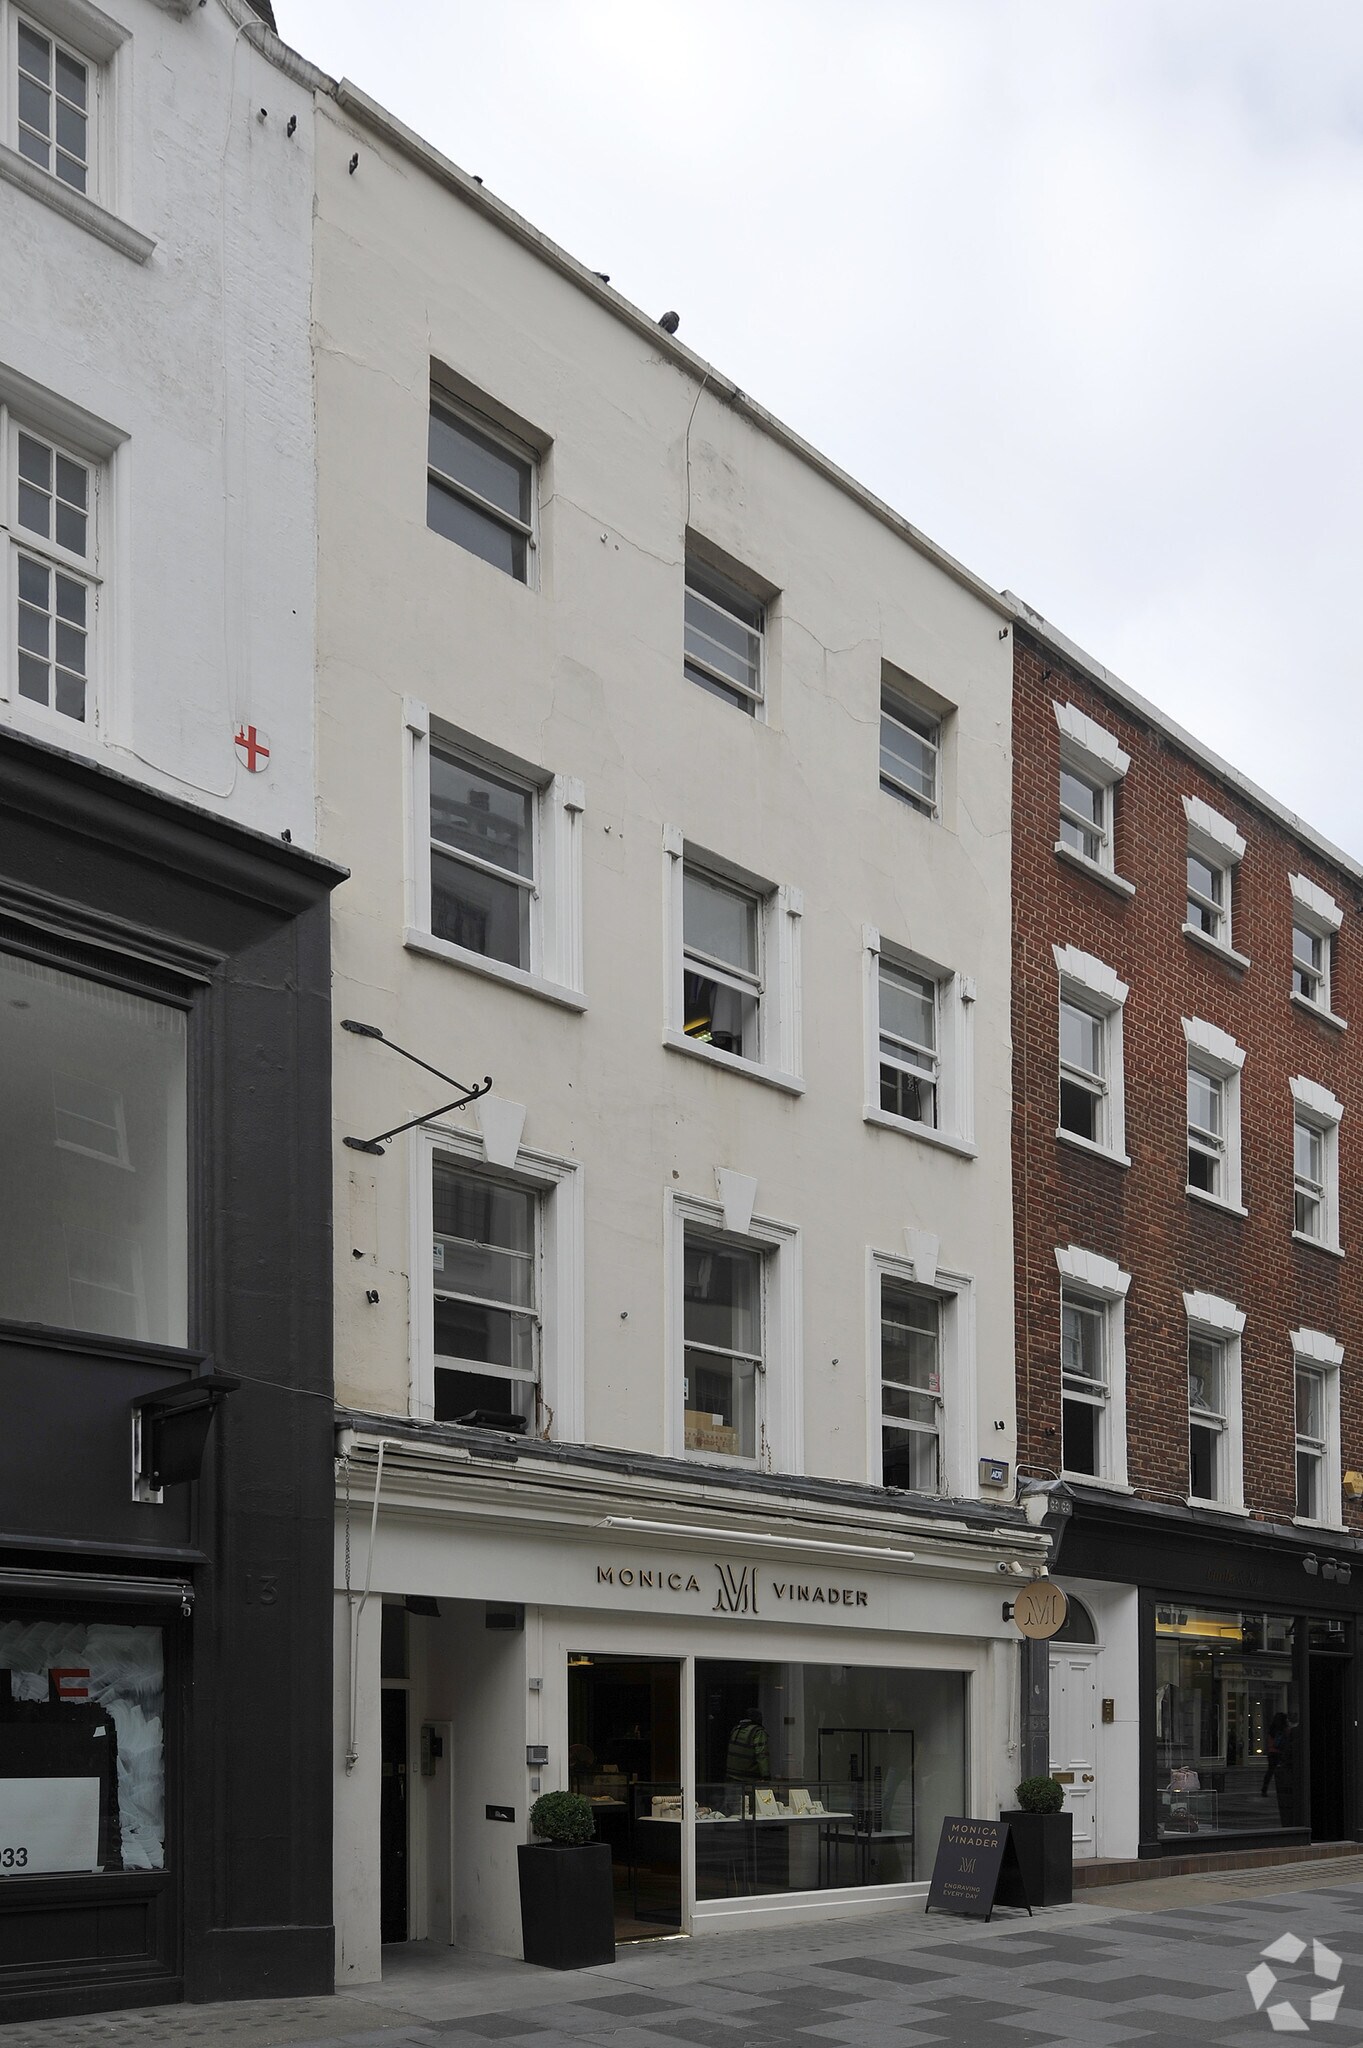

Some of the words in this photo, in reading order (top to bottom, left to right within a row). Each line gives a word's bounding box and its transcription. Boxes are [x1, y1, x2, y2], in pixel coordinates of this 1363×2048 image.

[596, 1565, 700, 1592] MONICA
[772, 1582, 869, 1607] VINADER
[952, 1824, 997, 1836] MONICA
[948, 1835, 998, 1848] VINADER
[0, 1847, 28, 1868] 33
[944, 1883, 980, 1892] ENGRAVING
[943, 1890, 964, 1898] EVERY
